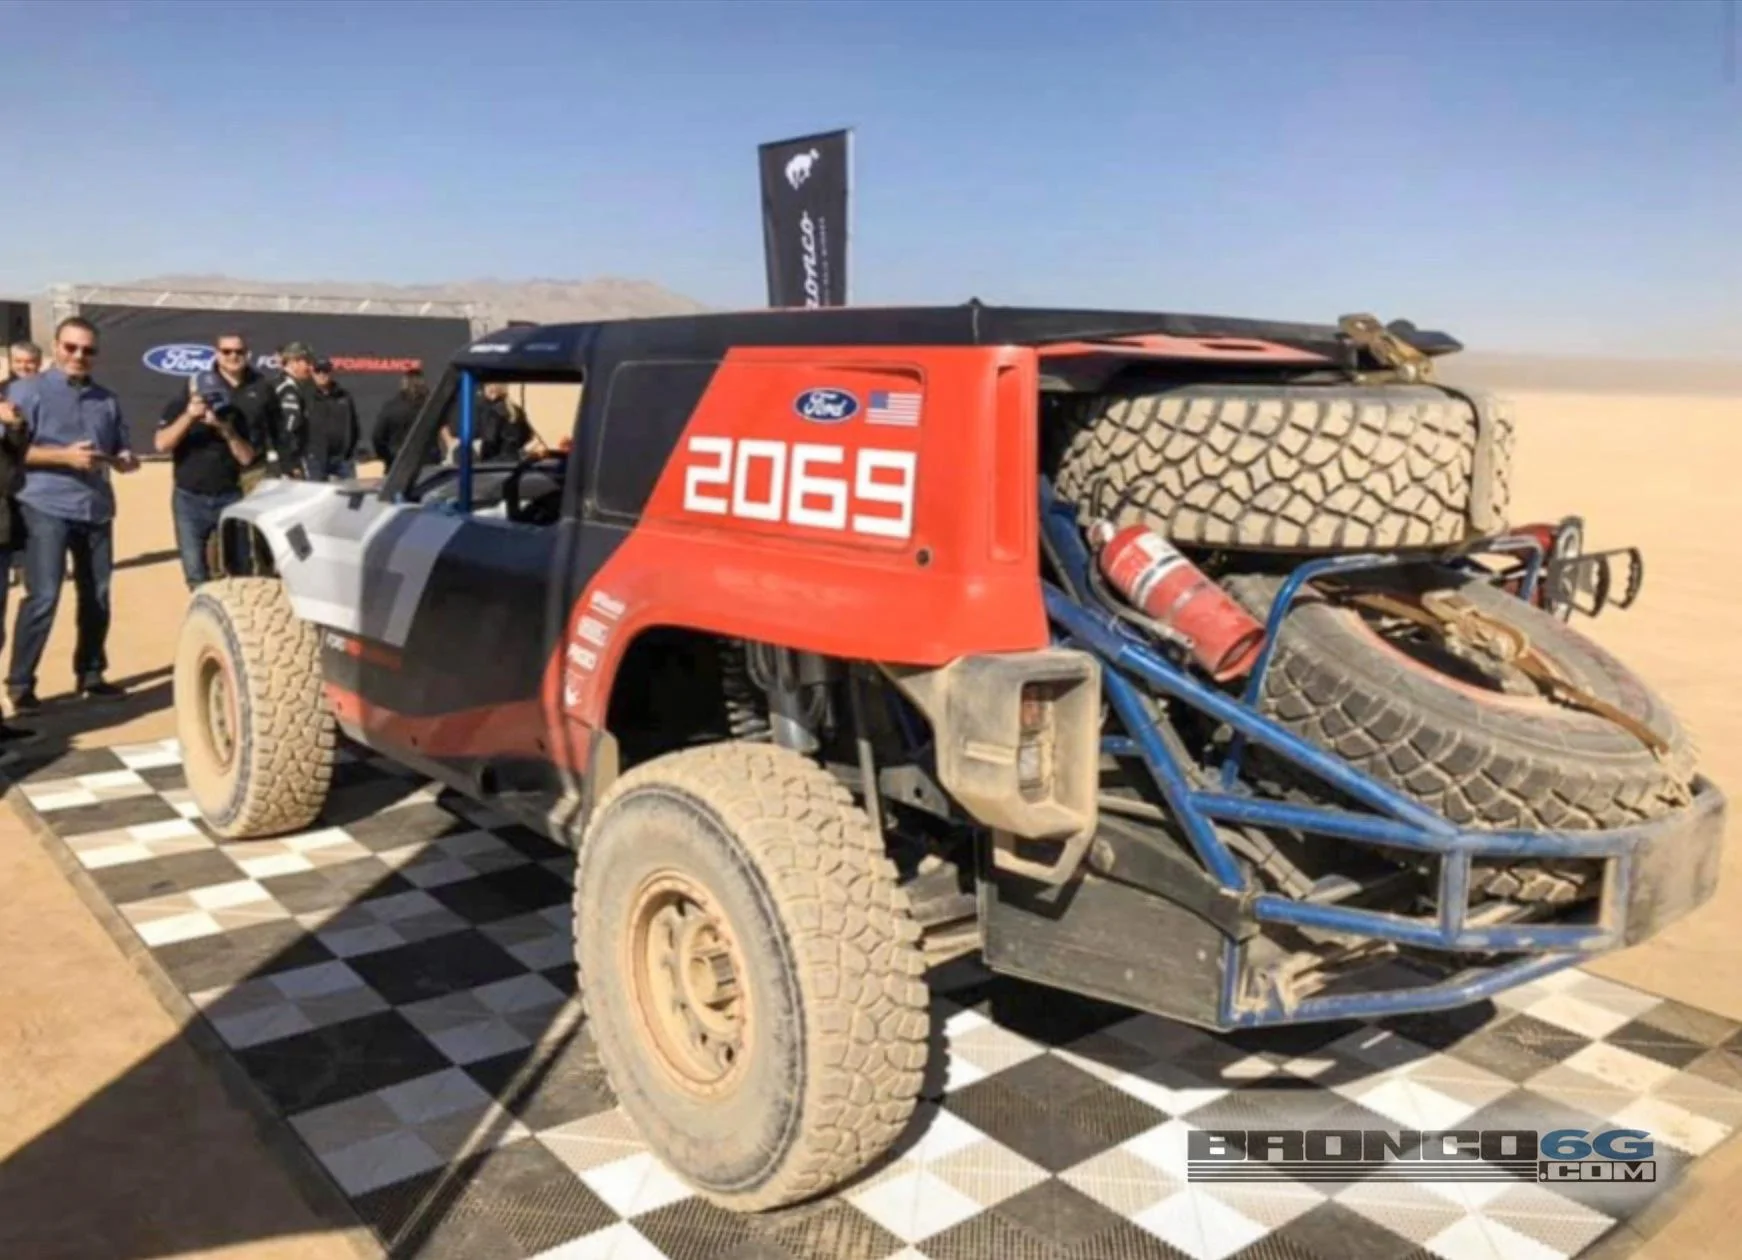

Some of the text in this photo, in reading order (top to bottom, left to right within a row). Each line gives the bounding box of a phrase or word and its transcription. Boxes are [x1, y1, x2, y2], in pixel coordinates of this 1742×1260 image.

[158, 348, 214, 372] Ford
[801, 390, 849, 418] Ford
[683, 435, 917, 539] 2069
